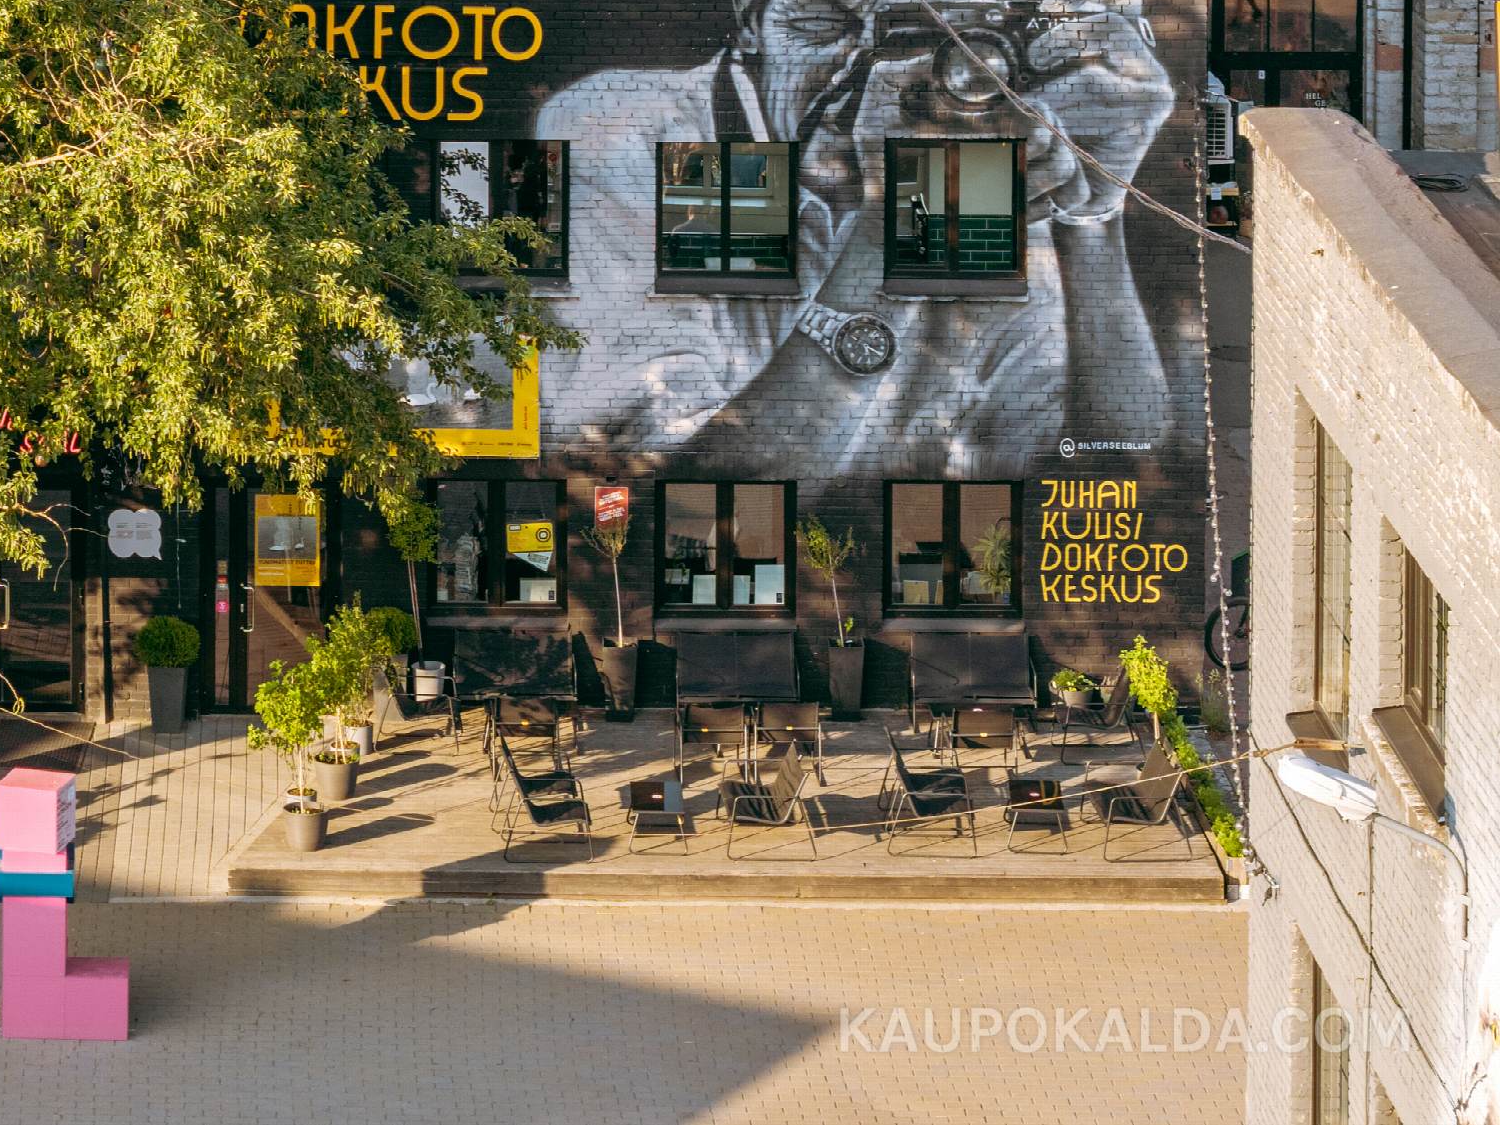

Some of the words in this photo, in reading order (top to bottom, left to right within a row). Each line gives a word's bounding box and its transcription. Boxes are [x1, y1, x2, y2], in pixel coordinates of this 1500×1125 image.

[241, 3, 543, 61] OKFOTO
[1041, 480, 1137, 509] JUHAN
[1040, 542, 1188, 572] DOKFOTO
[1040, 574, 1162, 604] KESKUS
